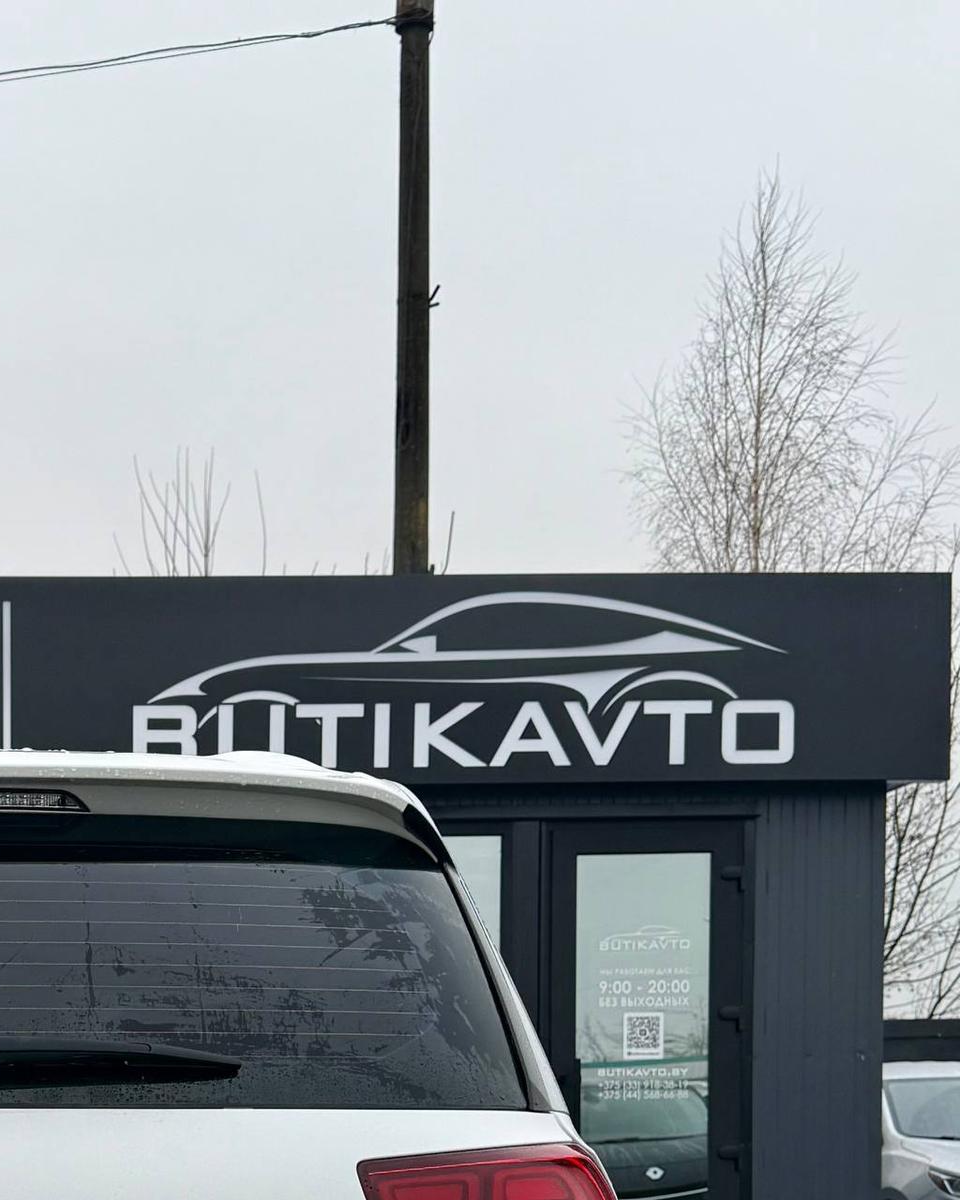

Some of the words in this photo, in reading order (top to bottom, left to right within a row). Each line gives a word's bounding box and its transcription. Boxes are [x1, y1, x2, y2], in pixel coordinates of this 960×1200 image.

[132, 699, 796, 768] BUTIKAVTO
[600, 939, 690, 951] BUTIKAVTO
[599, 980, 632, 994] 9:00
[648, 979, 690, 994] 20:00
[599, 996, 618, 1008] БЕЗ
[620, 996, 689, 1008] ВЫХОДНЫХ
[597, 1067, 689, 1078] BUTIKAVTO.BY
